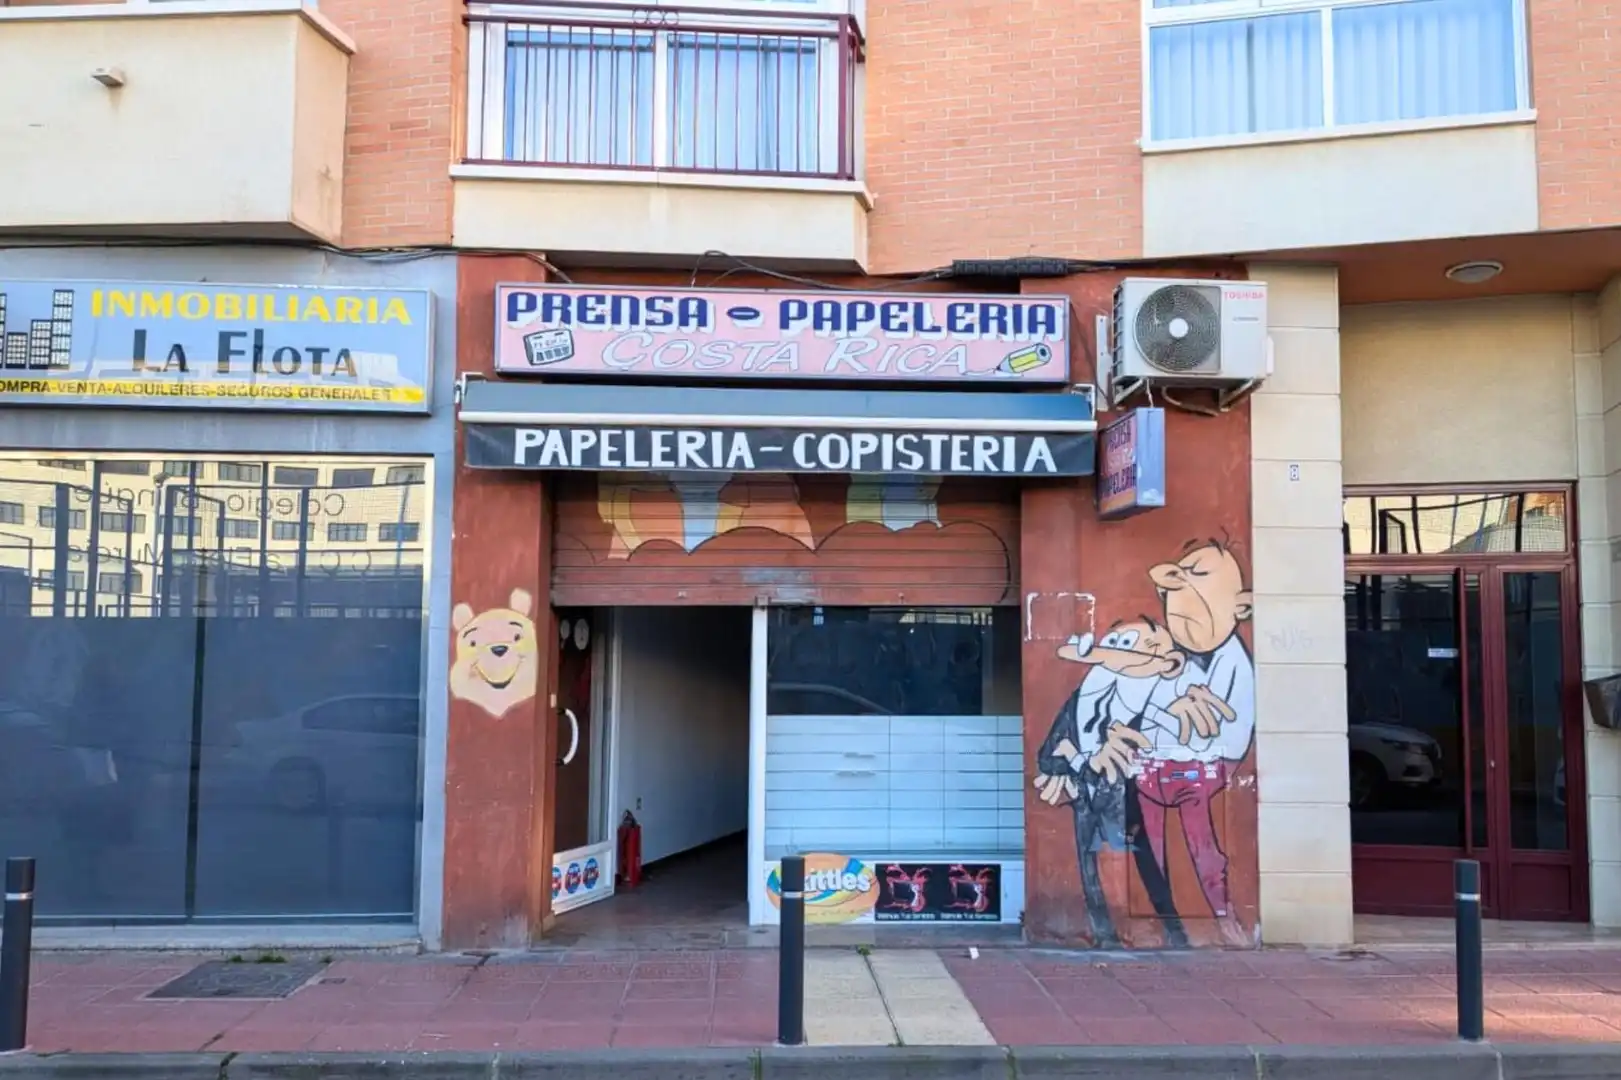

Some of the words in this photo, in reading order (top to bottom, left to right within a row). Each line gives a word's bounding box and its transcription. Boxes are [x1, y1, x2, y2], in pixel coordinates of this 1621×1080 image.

[91, 289, 412, 325] INMOBILIARIA
[1224, 291, 1264, 300] TOSHIBA
[507, 291, 715, 332] PRENSA
[779, 300, 1064, 342] PAPELERIA
[133, 328, 190, 373] LA
[601, 331, 800, 373] COSTA
[823, 337, 968, 375] RICA
[804, 868, 872, 892] ittles
